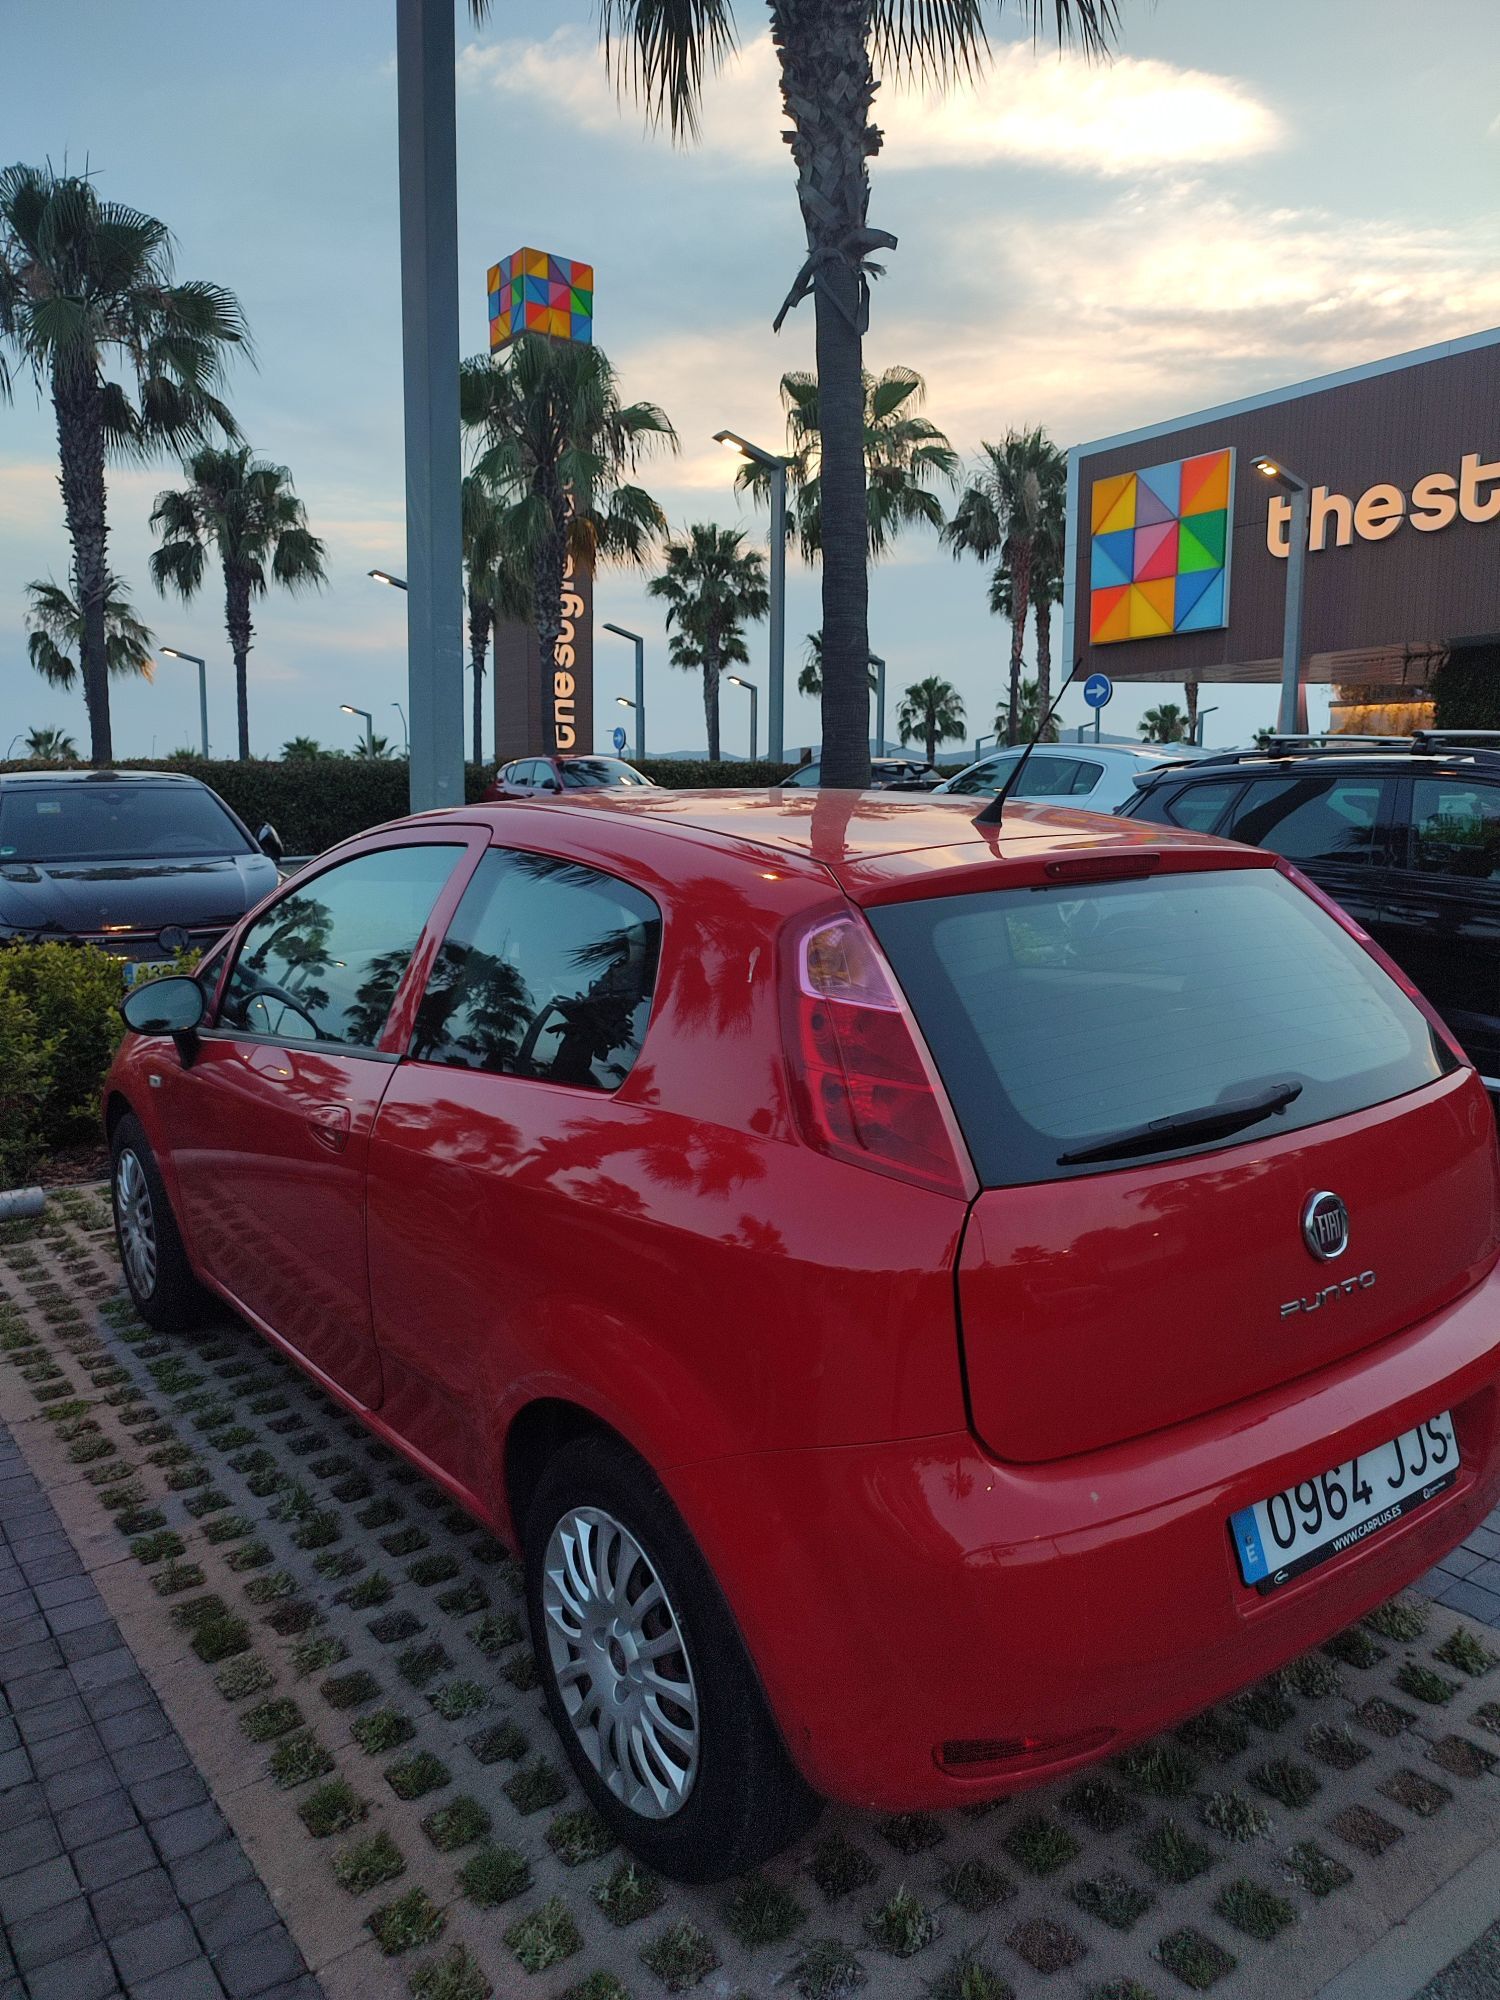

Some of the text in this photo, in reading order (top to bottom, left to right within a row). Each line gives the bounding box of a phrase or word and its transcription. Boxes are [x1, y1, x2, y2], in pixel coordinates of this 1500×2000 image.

[1315, 1209, 1342, 1244] FIAT
[1280, 1270, 1376, 1319] PUNTO
[1266, 1415, 1448, 1549] 0964 JJS
[1332, 1505, 1402, 1552] WWW.CARPLUS.ES
